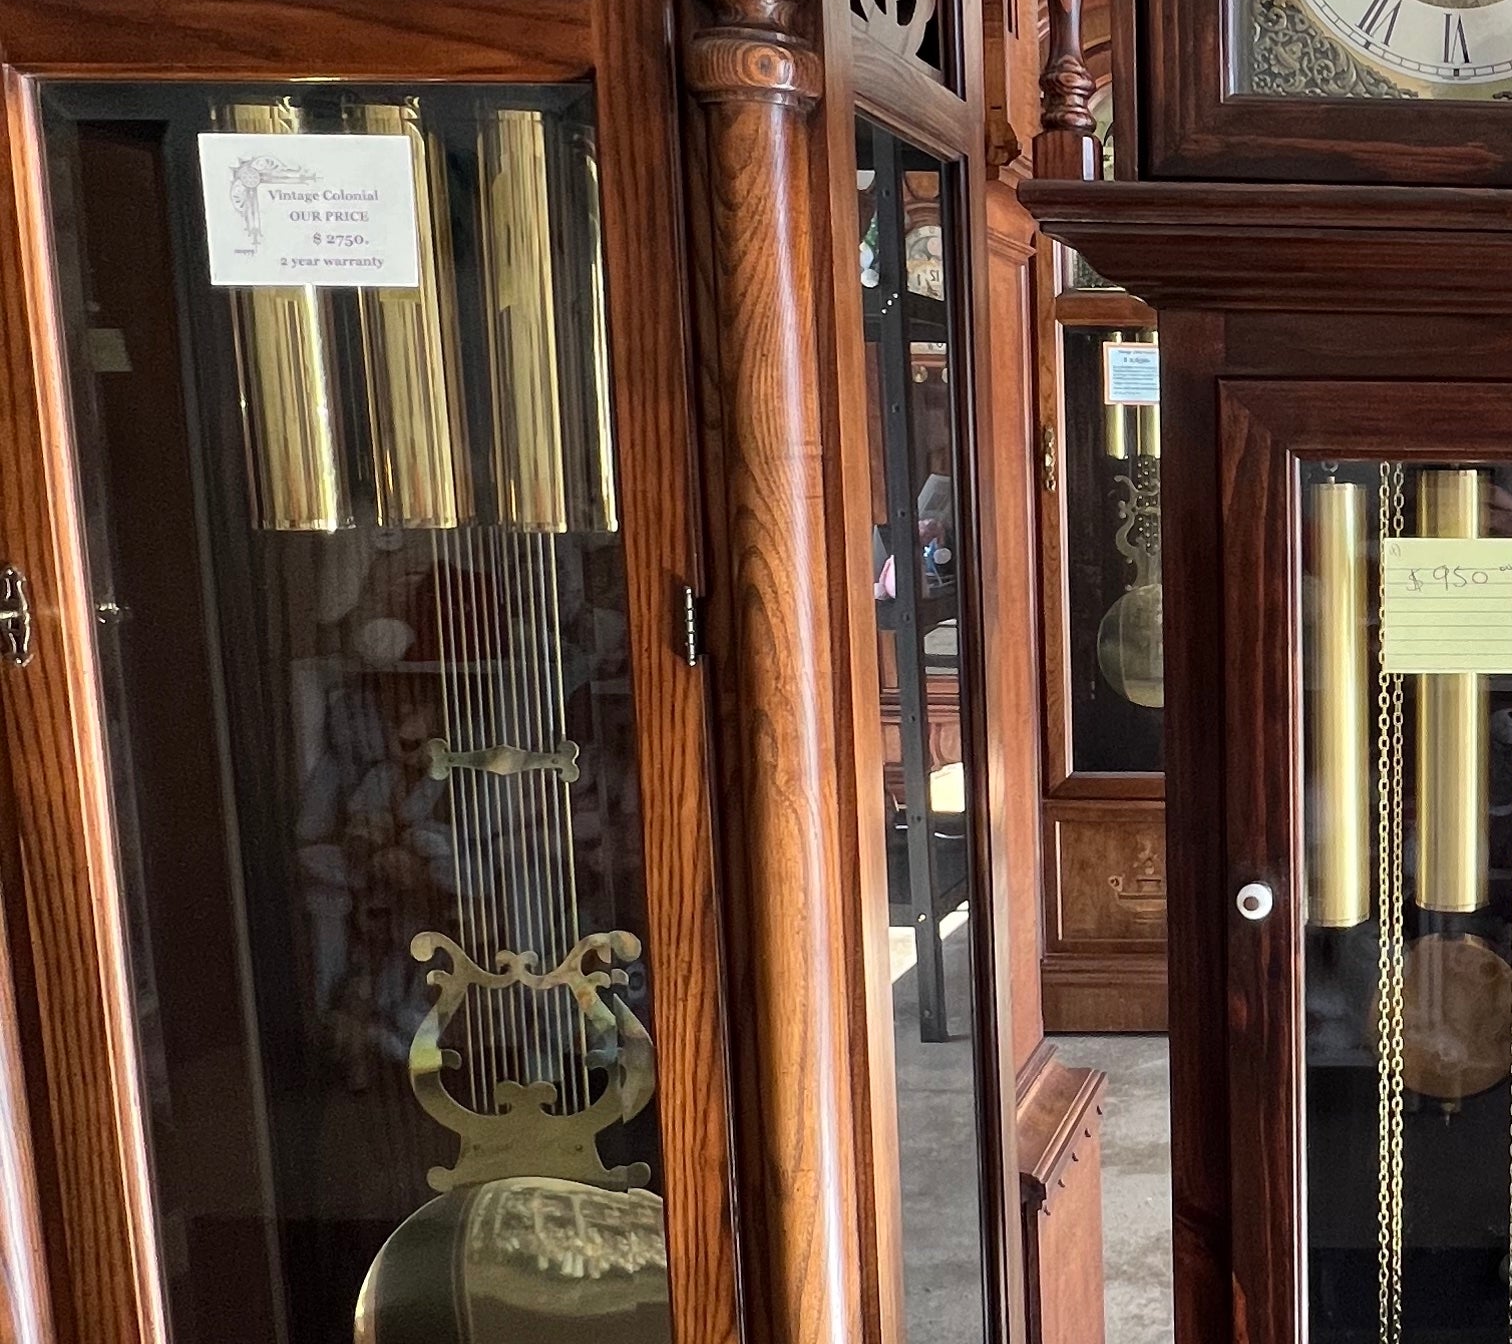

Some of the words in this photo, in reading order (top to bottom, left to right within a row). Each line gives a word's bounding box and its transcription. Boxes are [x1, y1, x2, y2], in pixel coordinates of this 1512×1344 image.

[1443, 12, 1471, 64] VI
[268, 189, 320, 204] Vintage
[323, 189, 379, 201] Colonial
[289, 211, 321, 223] OUR
[325, 211, 369, 222] PRICE
[312, 232, 321, 246] $
[326, 234, 370, 248] 2750.
[280, 257, 288, 267] 2
[292, 259, 320, 269] year
[323, 257, 384, 269] warranty
